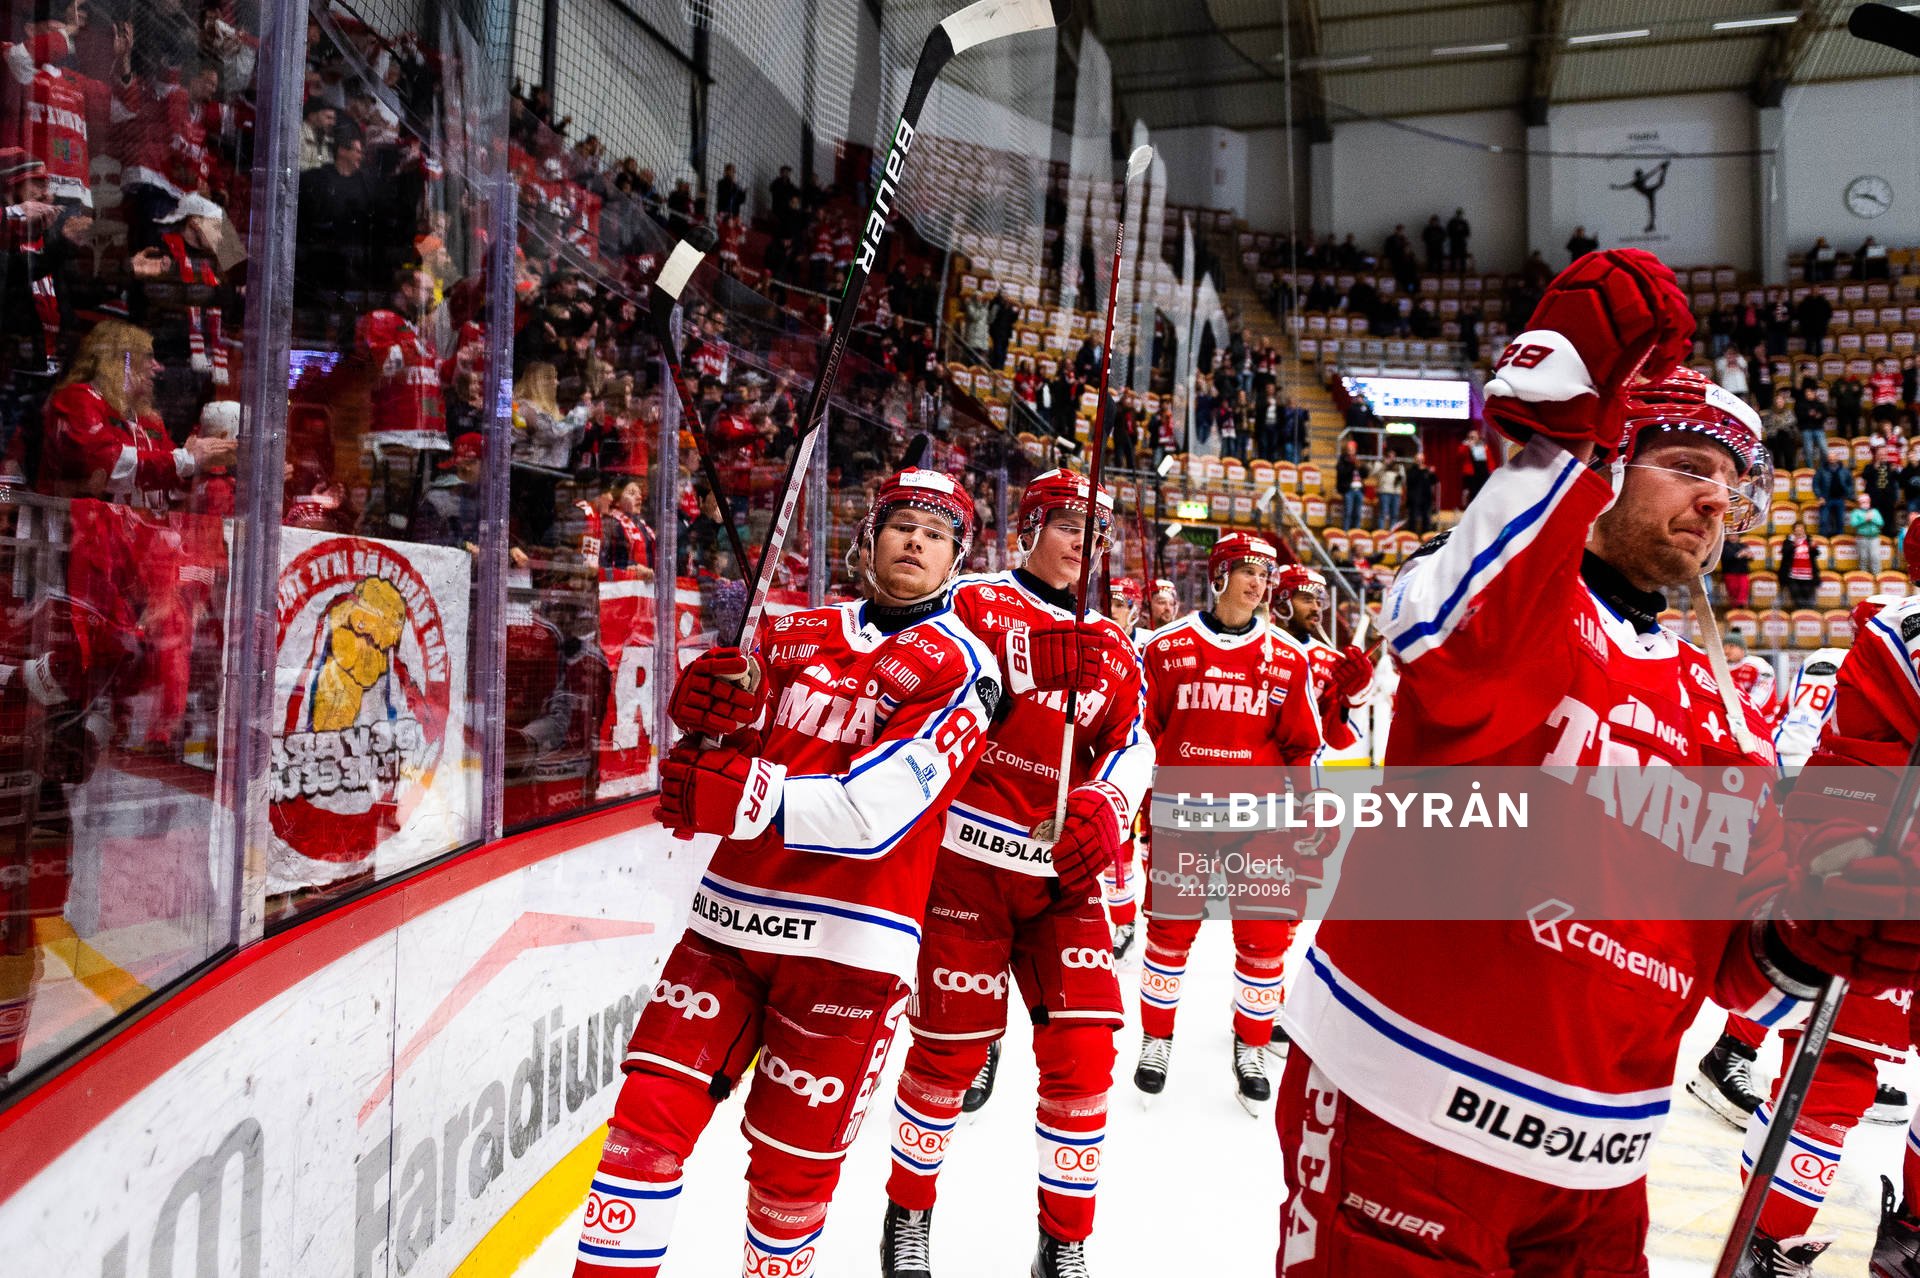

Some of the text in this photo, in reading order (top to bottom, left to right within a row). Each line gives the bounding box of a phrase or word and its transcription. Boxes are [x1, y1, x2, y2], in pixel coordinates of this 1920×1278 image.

[856, 117, 915, 275] BAUER
[998, 592, 1025, 609] SCA
[795, 617, 828, 627] SCA
[914, 638, 945, 665] SCA
[1172, 637, 1194, 647] SCA
[1275, 647, 1296, 661] SCA
[1222, 671, 1246, 681] NHC
[1176, 680, 1269, 717] TIMRÅ
[1794, 683, 1832, 711] 78
[1656, 720, 1689, 757] NHC
[996, 751, 1060, 780] consem
[744, 757, 772, 823] UER
[1823, 786, 1877, 802] BAUER
[692, 891, 817, 941] BILBOLAGET
[932, 906, 979, 921] BAUER
[1061, 947, 1117, 977] coo
[933, 967, 1009, 1000] coop
[651, 979, 721, 1020] oop
[811, 1003, 875, 1020] BAUER
[758, 1043, 845, 1107] coop
[1446, 1086, 1652, 1166] BILBOLAGET
[602, 1141, 629, 1157] AUER
[759, 1206, 807, 1223] BAUER
[1344, 1192, 1445, 1241] BAUER
